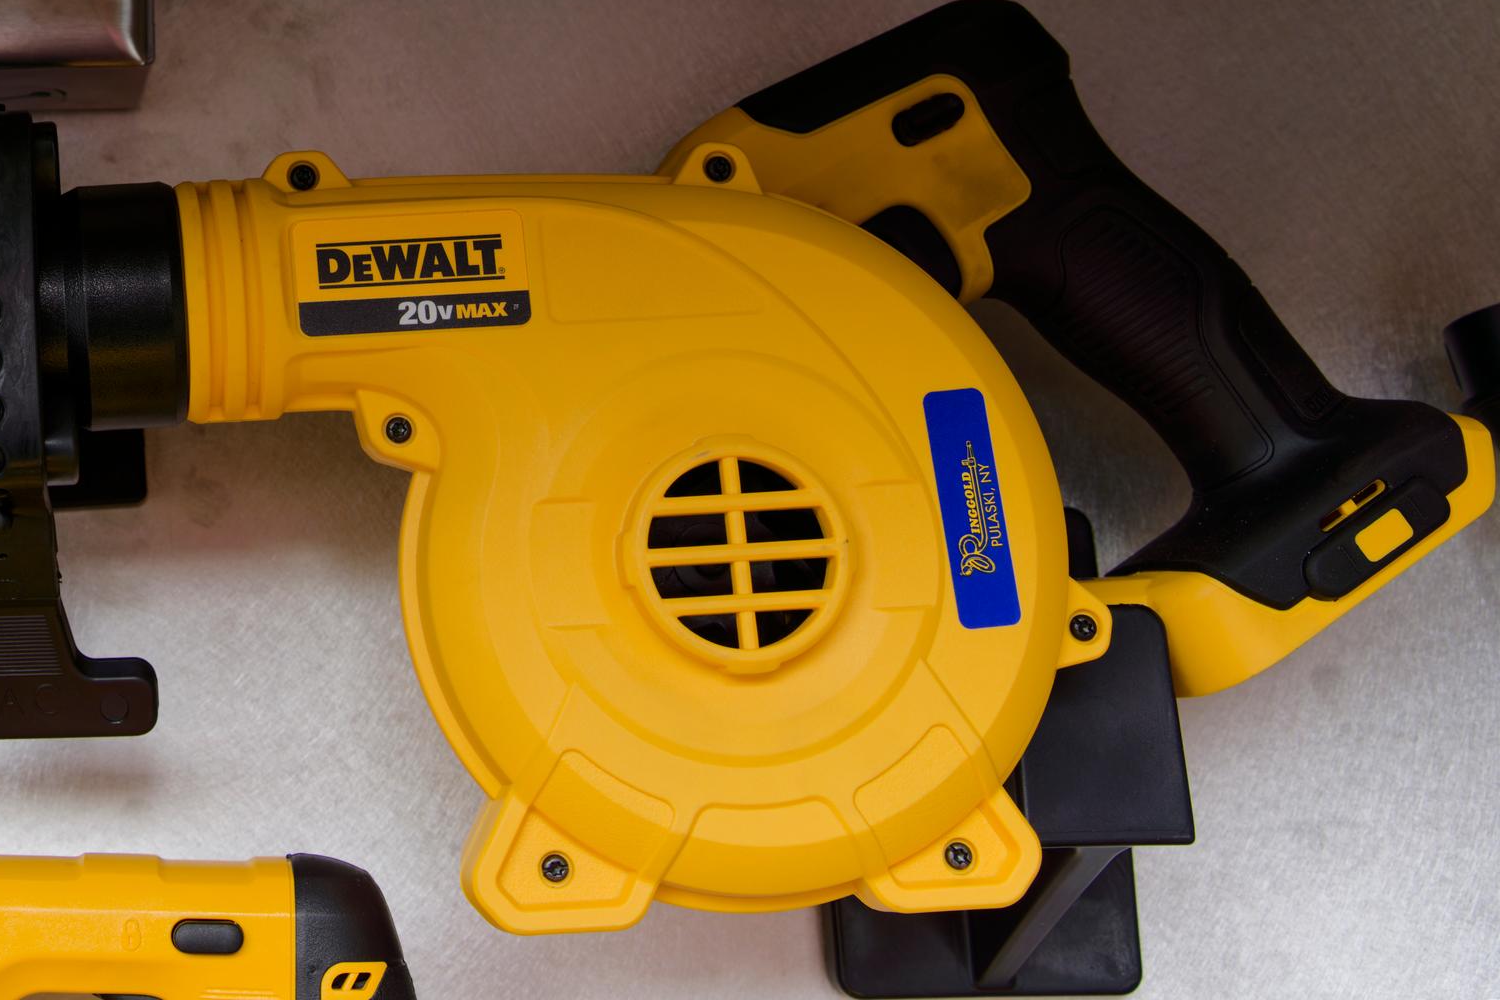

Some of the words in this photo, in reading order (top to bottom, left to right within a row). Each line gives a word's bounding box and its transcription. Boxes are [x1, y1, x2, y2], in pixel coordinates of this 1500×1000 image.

[316, 238, 503, 285] DEWALT
[456, 302, 508, 320] MAX
[977, 463, 993, 483] NY
